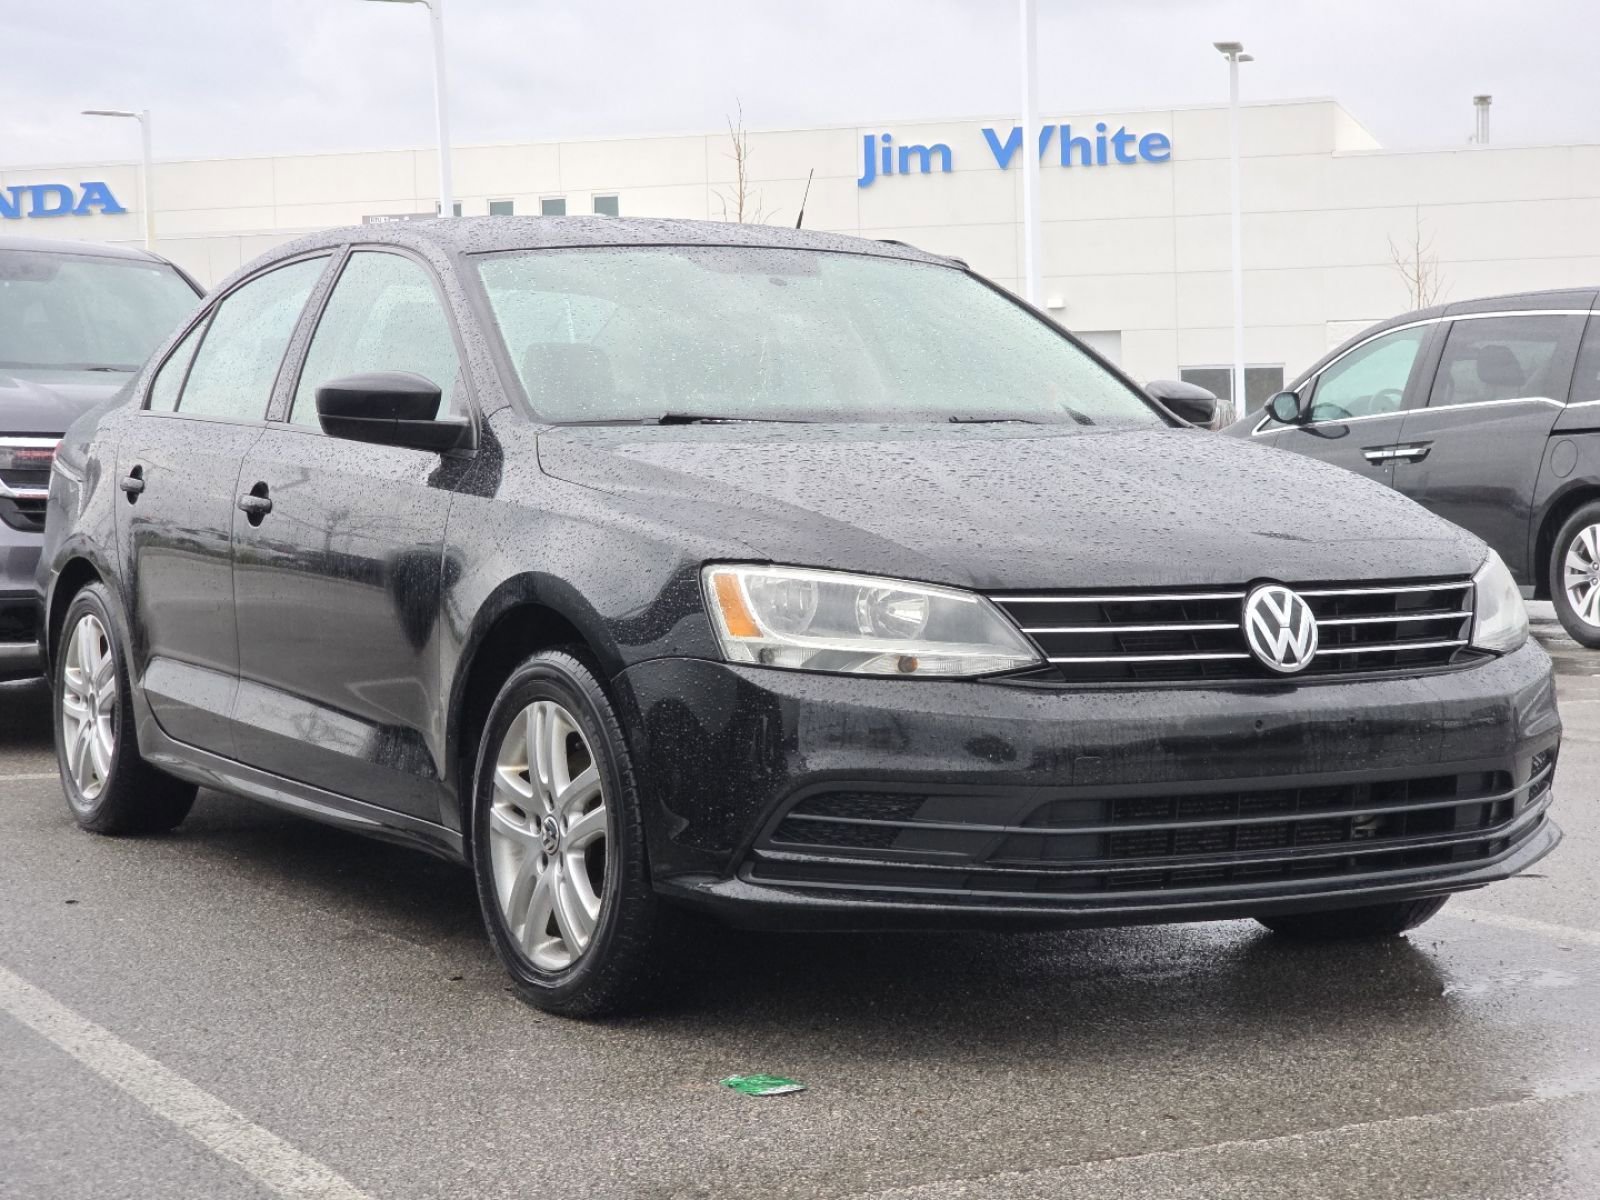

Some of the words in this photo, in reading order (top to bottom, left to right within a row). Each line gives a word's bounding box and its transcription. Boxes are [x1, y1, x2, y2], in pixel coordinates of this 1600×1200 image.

[857, 133, 953, 188] Jim
[981, 122, 1171, 170] White
[1245, 587, 1317, 670] VW
